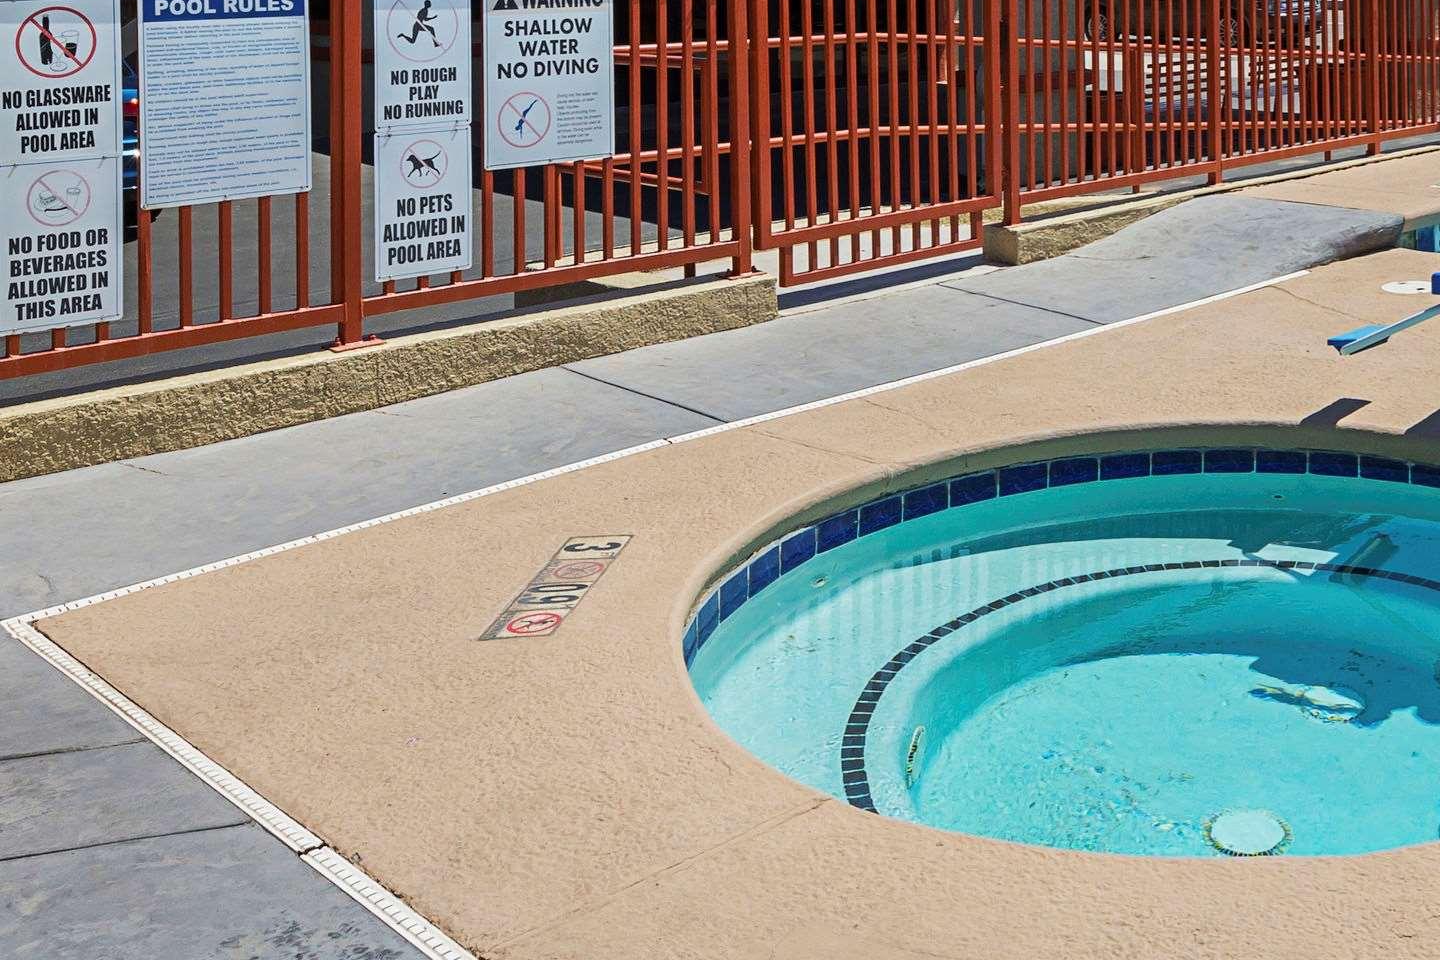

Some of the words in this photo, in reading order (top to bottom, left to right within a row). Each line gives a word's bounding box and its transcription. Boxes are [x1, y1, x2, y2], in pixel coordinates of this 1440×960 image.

[504, 18, 592, 37] SHALLOW
[518, 39, 578, 56] WATER
[391, 70, 408, 85] NO
[412, 67, 457, 83] ROUGH
[497, 62, 528, 79] NO
[534, 58, 599, 77] DIVING
[2, 90, 22, 109] NO
[26, 84, 111, 108] GLASSWARE
[409, 85, 439, 101] PLAY
[16, 109, 81, 132] ALLOWED
[85, 108, 98, 125] IN
[384, 104, 401, 120] NO
[405, 100, 463, 118] RUNNING
[21, 133, 56, 154] POOL
[60, 130, 95, 150] AREA
[396, 198, 416, 218] NO
[420, 193, 453, 214] PETS
[383, 218, 447, 242] ALLOWED
[451, 215, 465, 233] IN
[8, 236, 31, 256] NO
[37, 231, 81, 252] FOOD
[86, 228, 108, 246] OR
[388, 244, 423, 266] POOL
[427, 239, 461, 260] AREA
[10, 250, 107, 278] BEVERAGES
[8, 275, 87, 300] ALLOWED
[92, 271, 109, 289] IN
[15, 299, 56, 321] THIS
[60, 294, 103, 315] AREA
[564, 542, 621, 552] 3
